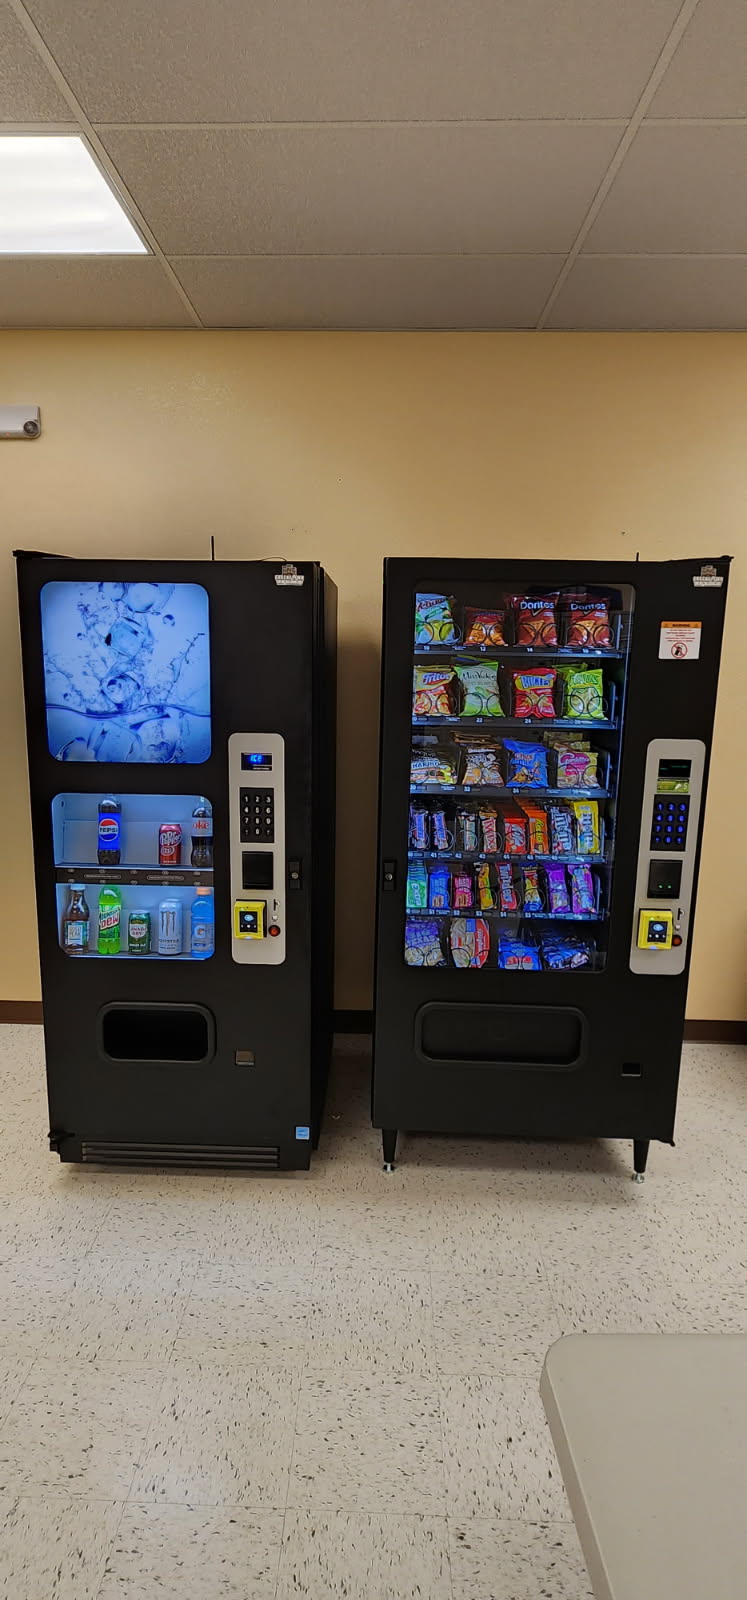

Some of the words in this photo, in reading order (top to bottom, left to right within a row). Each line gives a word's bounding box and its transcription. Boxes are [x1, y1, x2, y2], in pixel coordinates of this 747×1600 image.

[520, 601, 555, 610] Doritos
[422, 672, 449, 685] Fritos
[484, 818, 496, 847] TWIX
[411, 883, 421, 906] Extra
[407, 935, 436, 946] TEXAS
